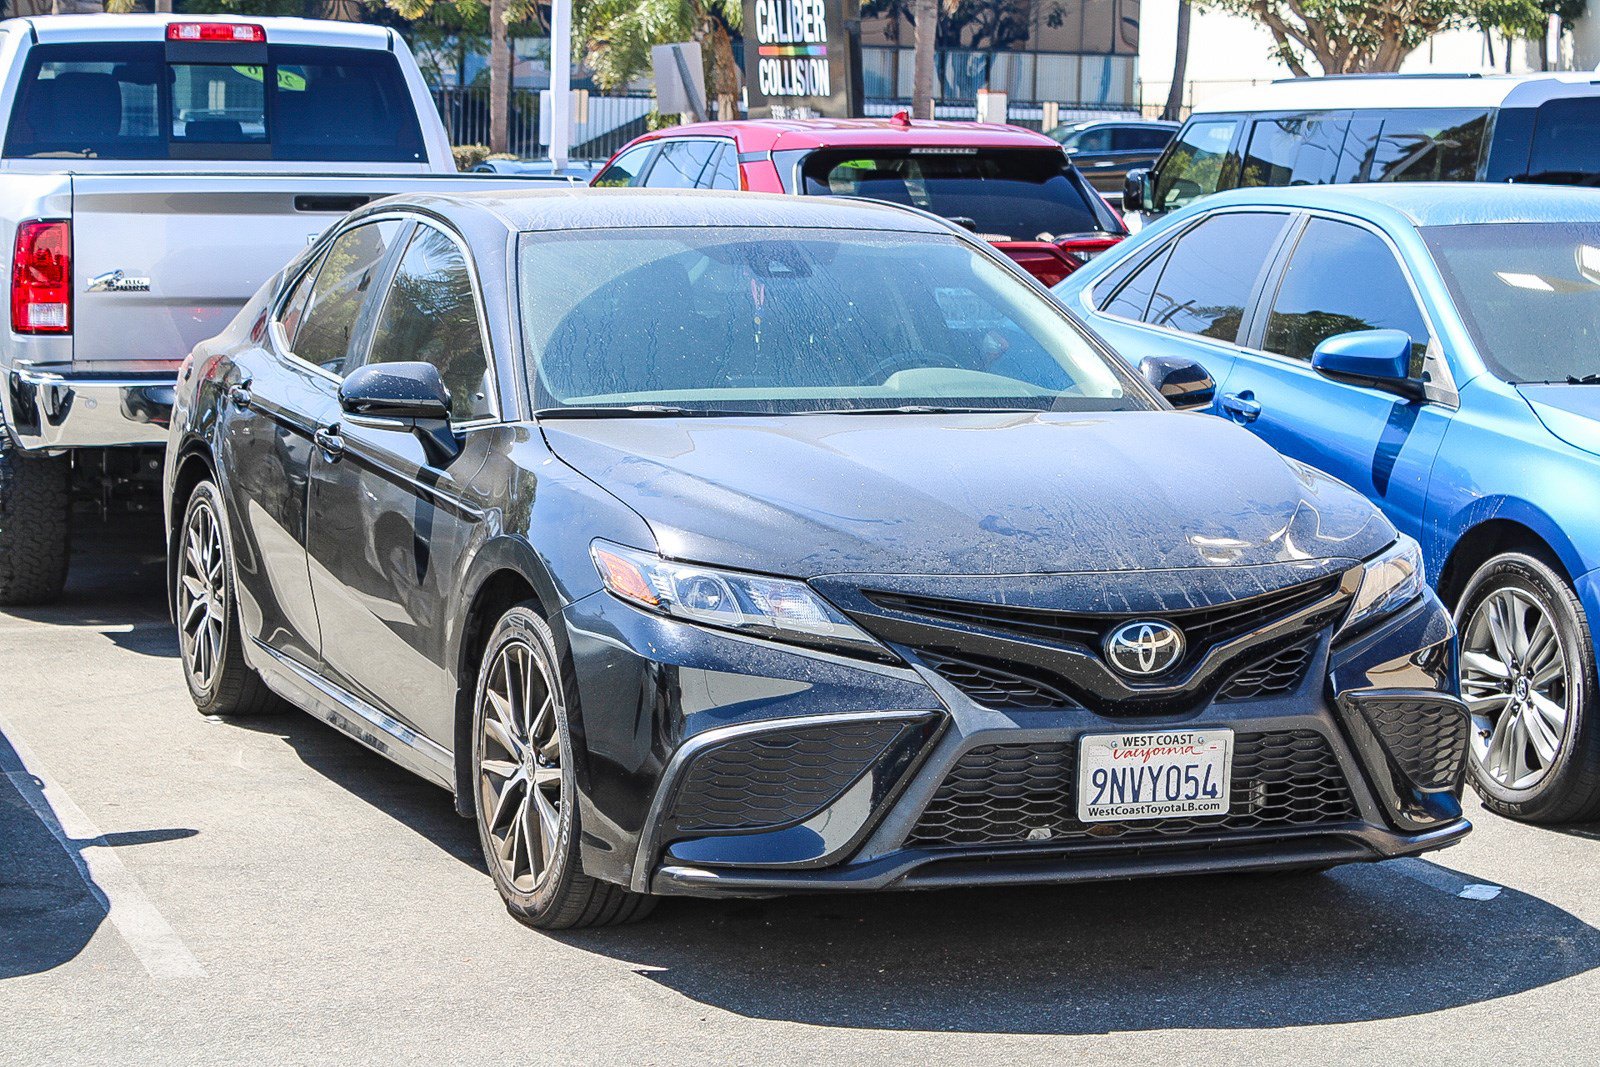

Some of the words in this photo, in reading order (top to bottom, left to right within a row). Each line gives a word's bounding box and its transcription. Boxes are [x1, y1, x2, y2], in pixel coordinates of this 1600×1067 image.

[756, 0, 827, 43] CALIBER
[758, 59, 830, 96] COLLISION
[1122, 736, 1154, 747] WEST
[1156, 734, 1194, 746] COAST
[1089, 763, 1218, 805] 9NVY054
[1088, 802, 1220, 817] WestCoastToyotaLB.com
